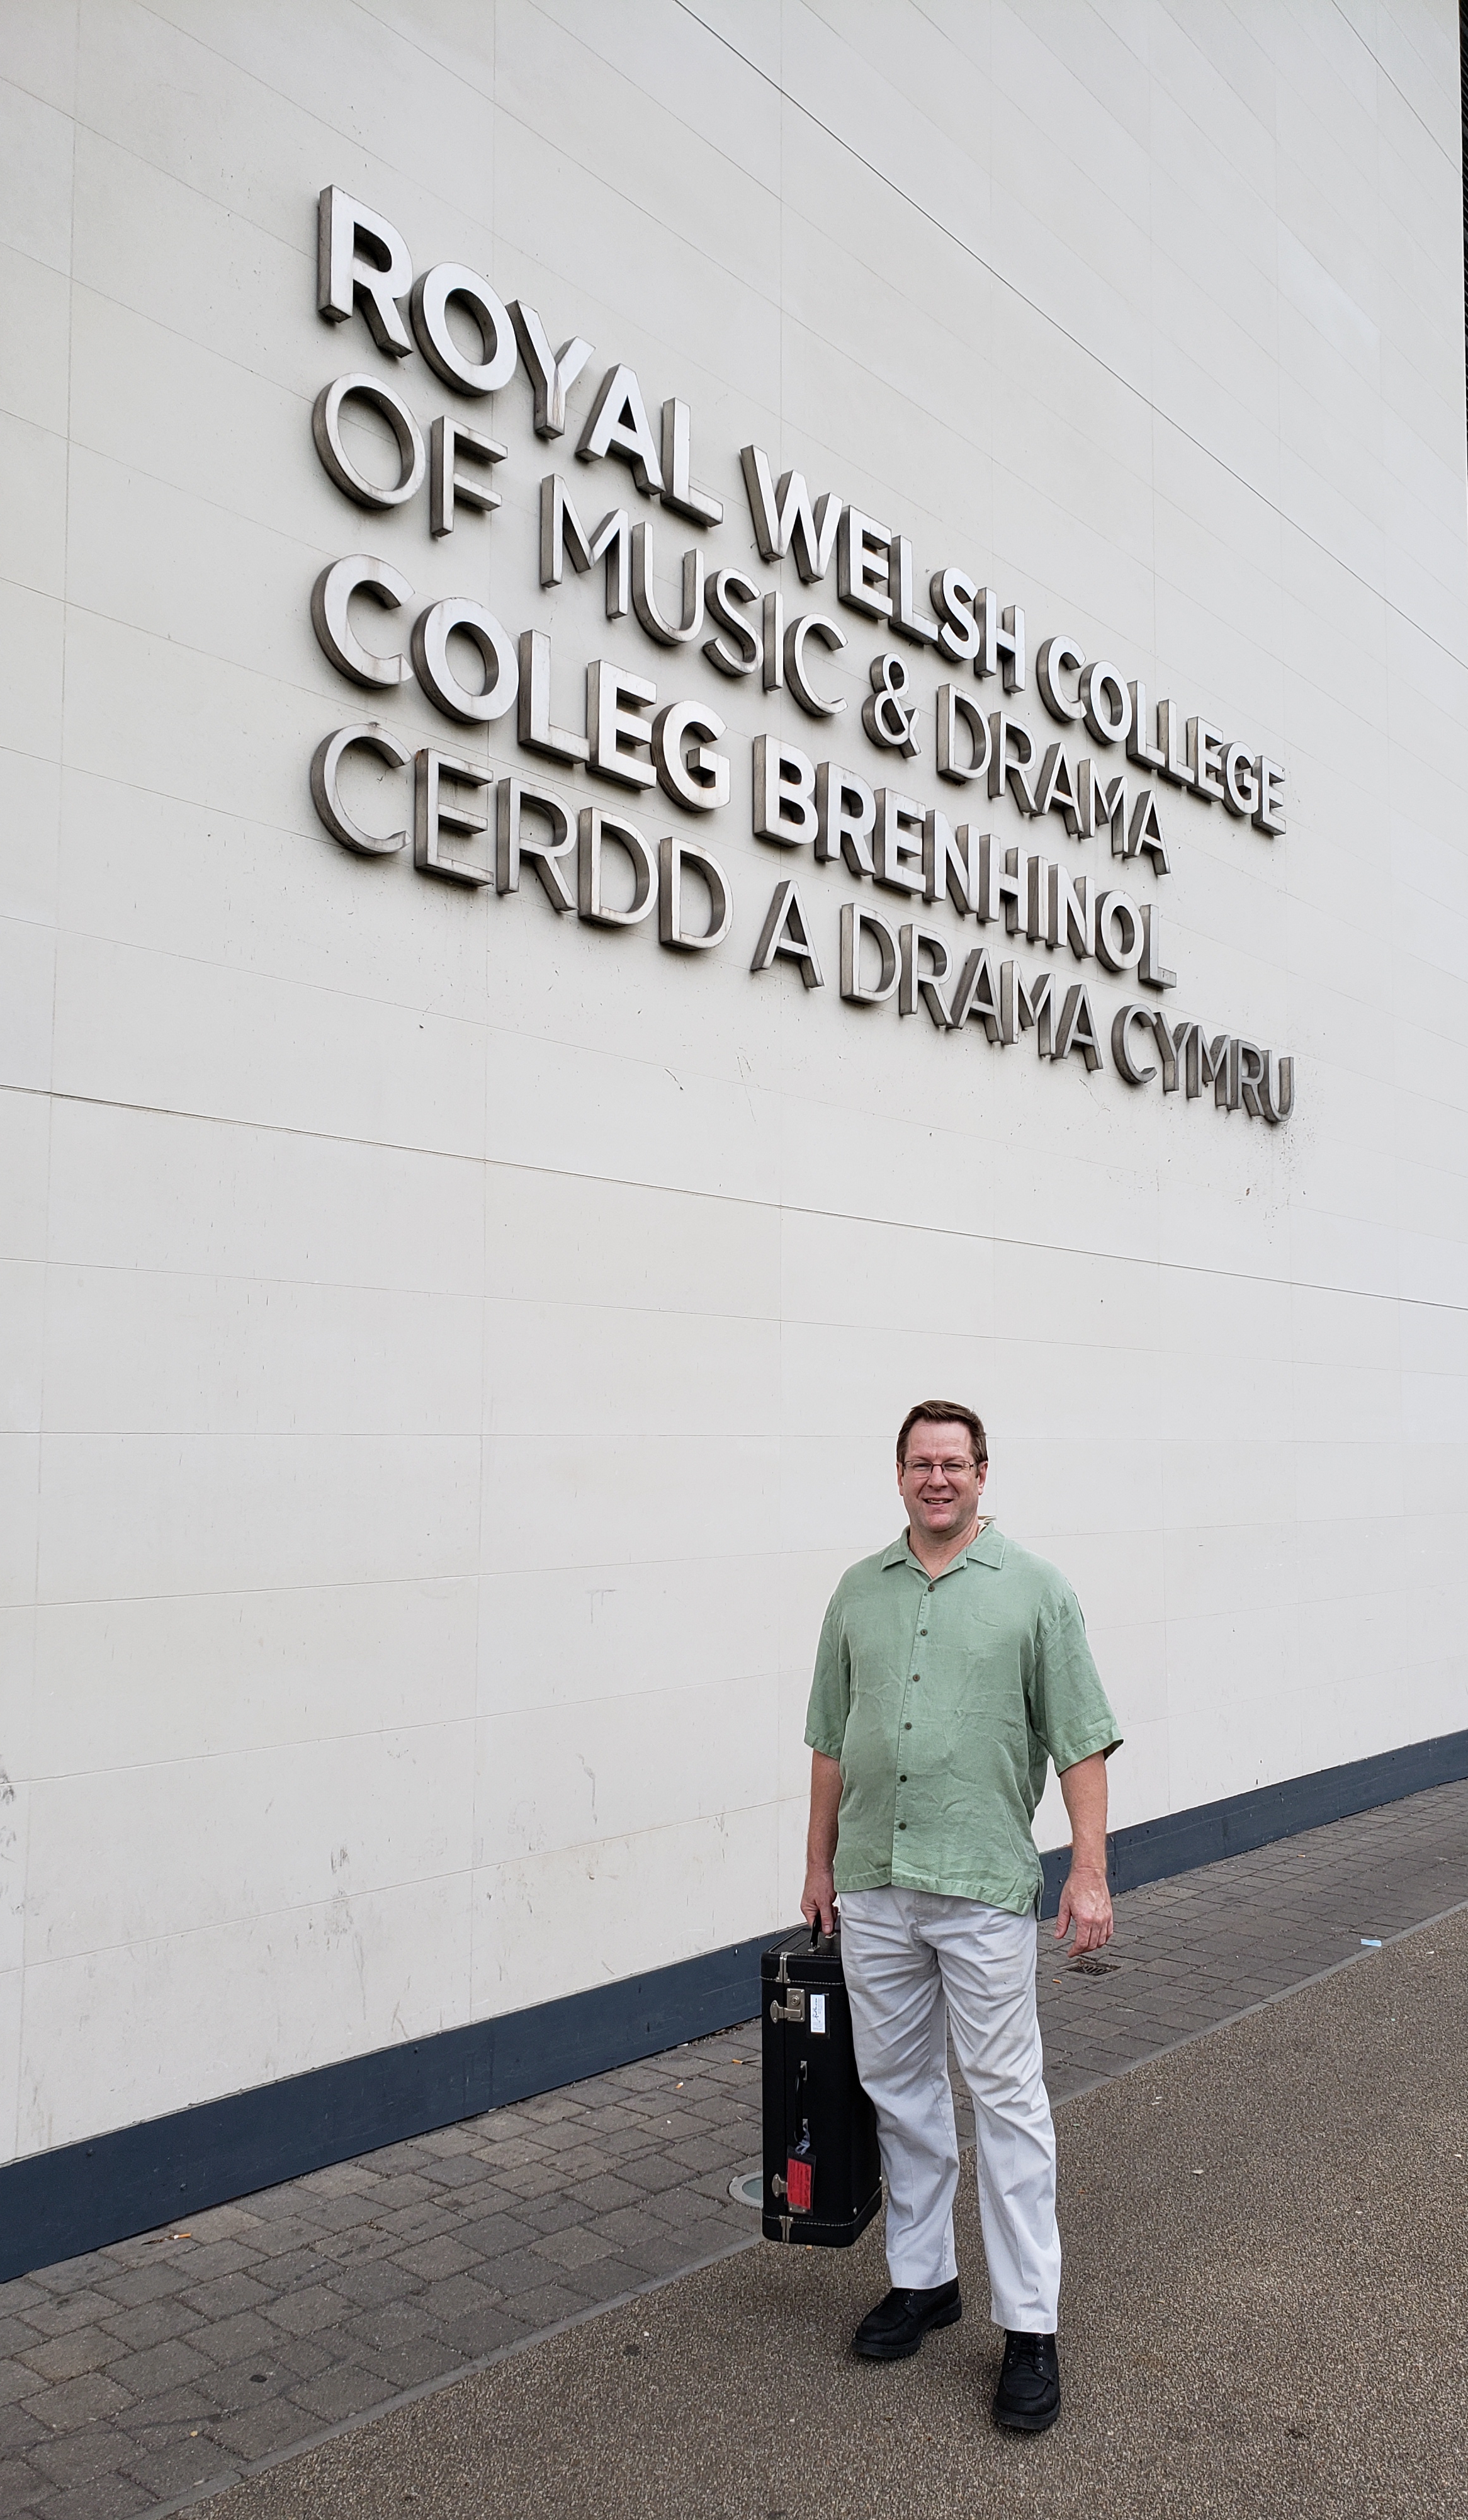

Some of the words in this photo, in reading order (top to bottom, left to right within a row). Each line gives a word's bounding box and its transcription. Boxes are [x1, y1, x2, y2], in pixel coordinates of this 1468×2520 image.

[312, 372, 508, 537] OF
[540, 474, 848, 717] MUSIC
[862, 652, 921, 757] &
[937, 683, 1170, 875] DRAMA
[318, 184, 723, 528] ROYAL
[740, 445, 1025, 693] WELSH
[1036, 635, 1286, 836] COLLEGE
[311, 553, 730, 812] COLEG
[754, 734, 1177, 989] BRENHINOL
[311, 722, 733, 951] CERDD
[752, 880, 824, 988] A
[840, 903, 1103, 1071] DRAMA
[1111, 1004, 1294, 1123] CYMRU
